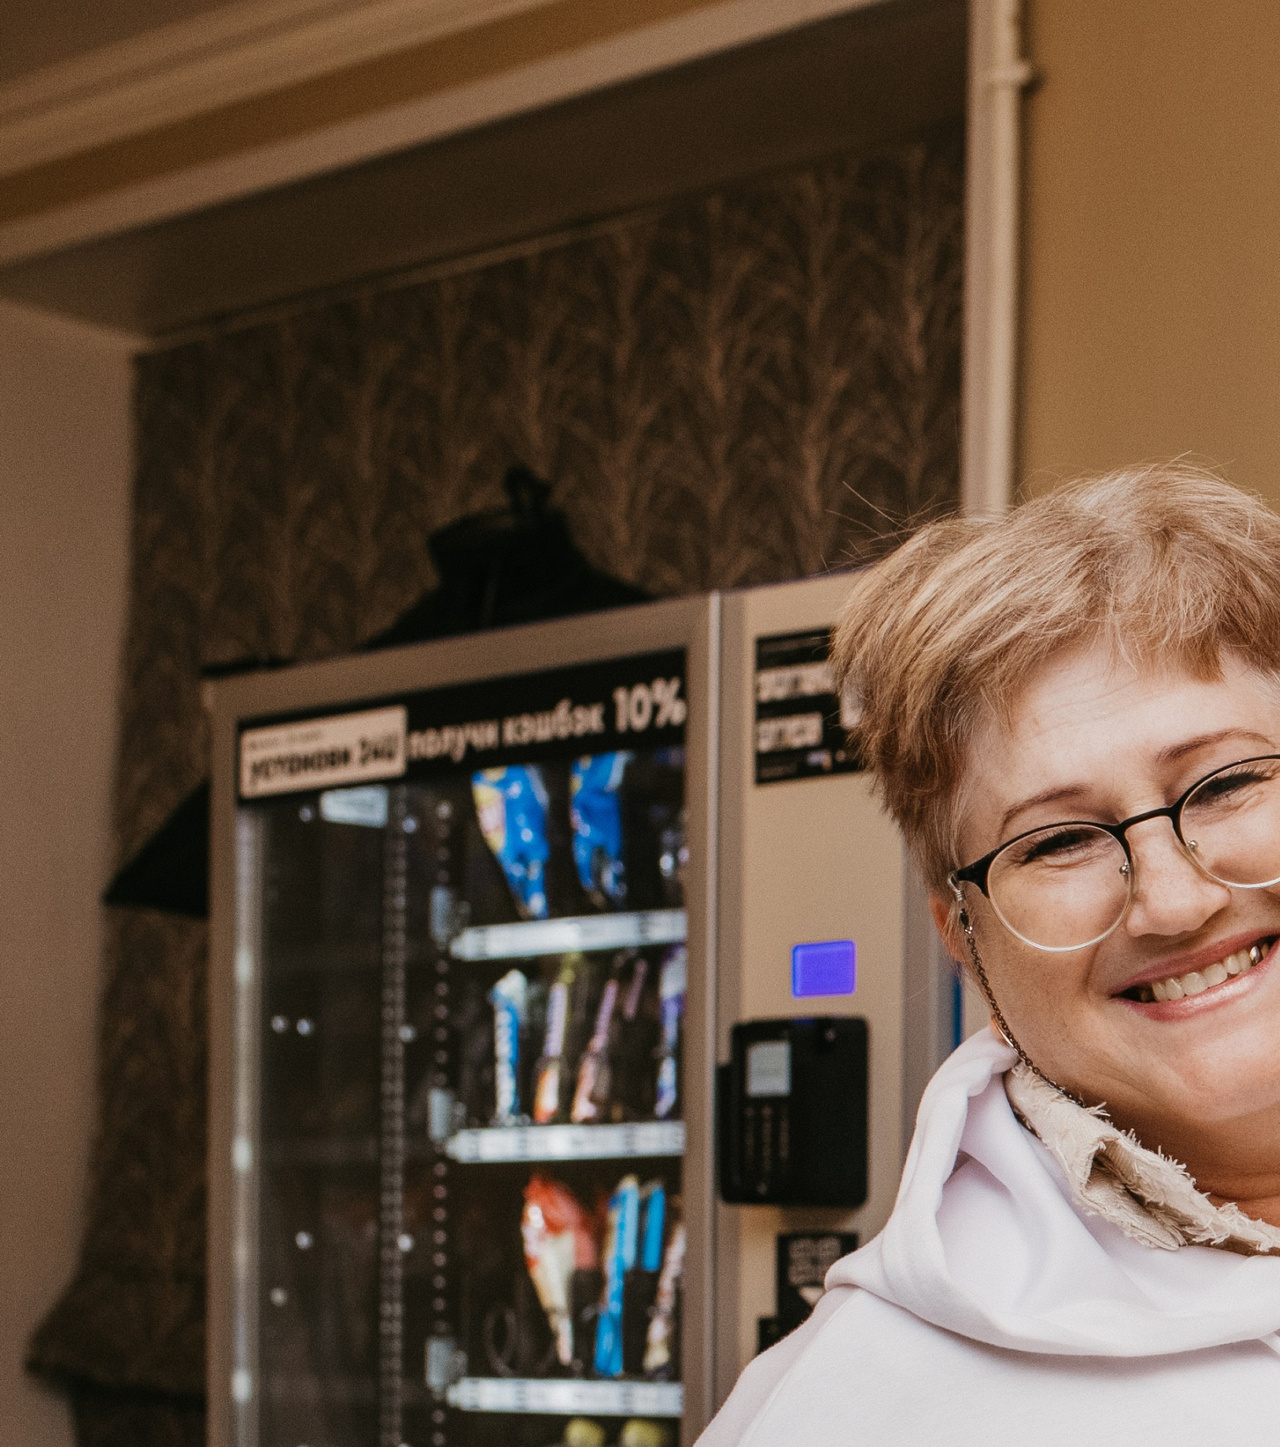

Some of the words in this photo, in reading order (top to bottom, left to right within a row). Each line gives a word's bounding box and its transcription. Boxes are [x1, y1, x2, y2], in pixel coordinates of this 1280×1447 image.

[406, 719, 499, 763] получи
[502, 698, 605, 746] кэшбэк
[612, 676, 688, 733] 10%
